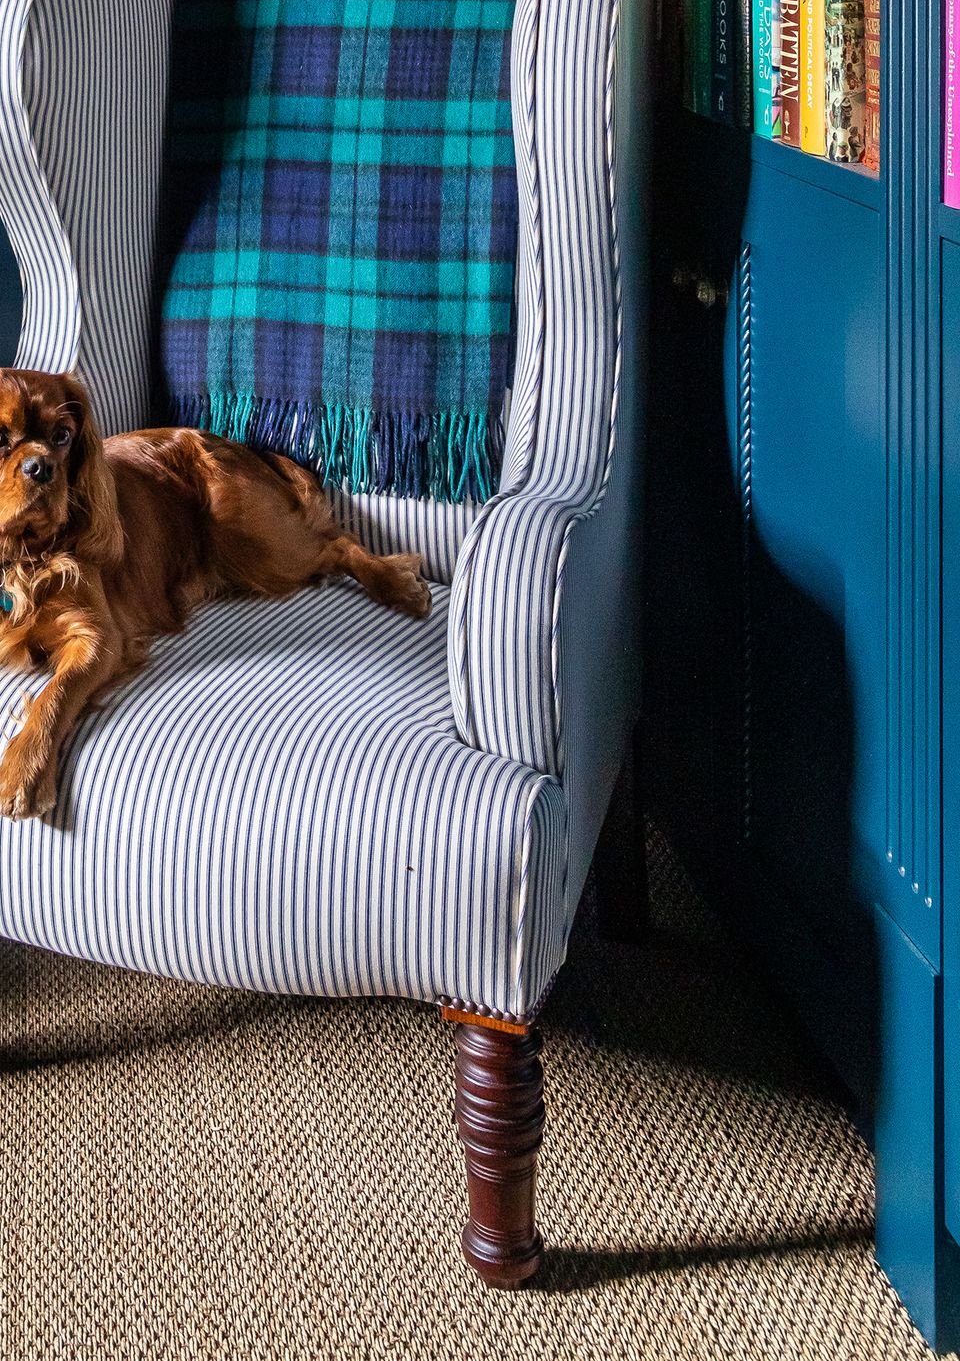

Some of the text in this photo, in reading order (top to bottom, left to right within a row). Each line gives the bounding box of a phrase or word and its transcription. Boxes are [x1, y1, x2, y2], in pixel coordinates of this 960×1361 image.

[807, 9, 815, 71] POLITICAL
[806, 75, 814, 110] DECAY
[947, 59, 956, 80] the
[946, 82, 957, 177] Unexplained
